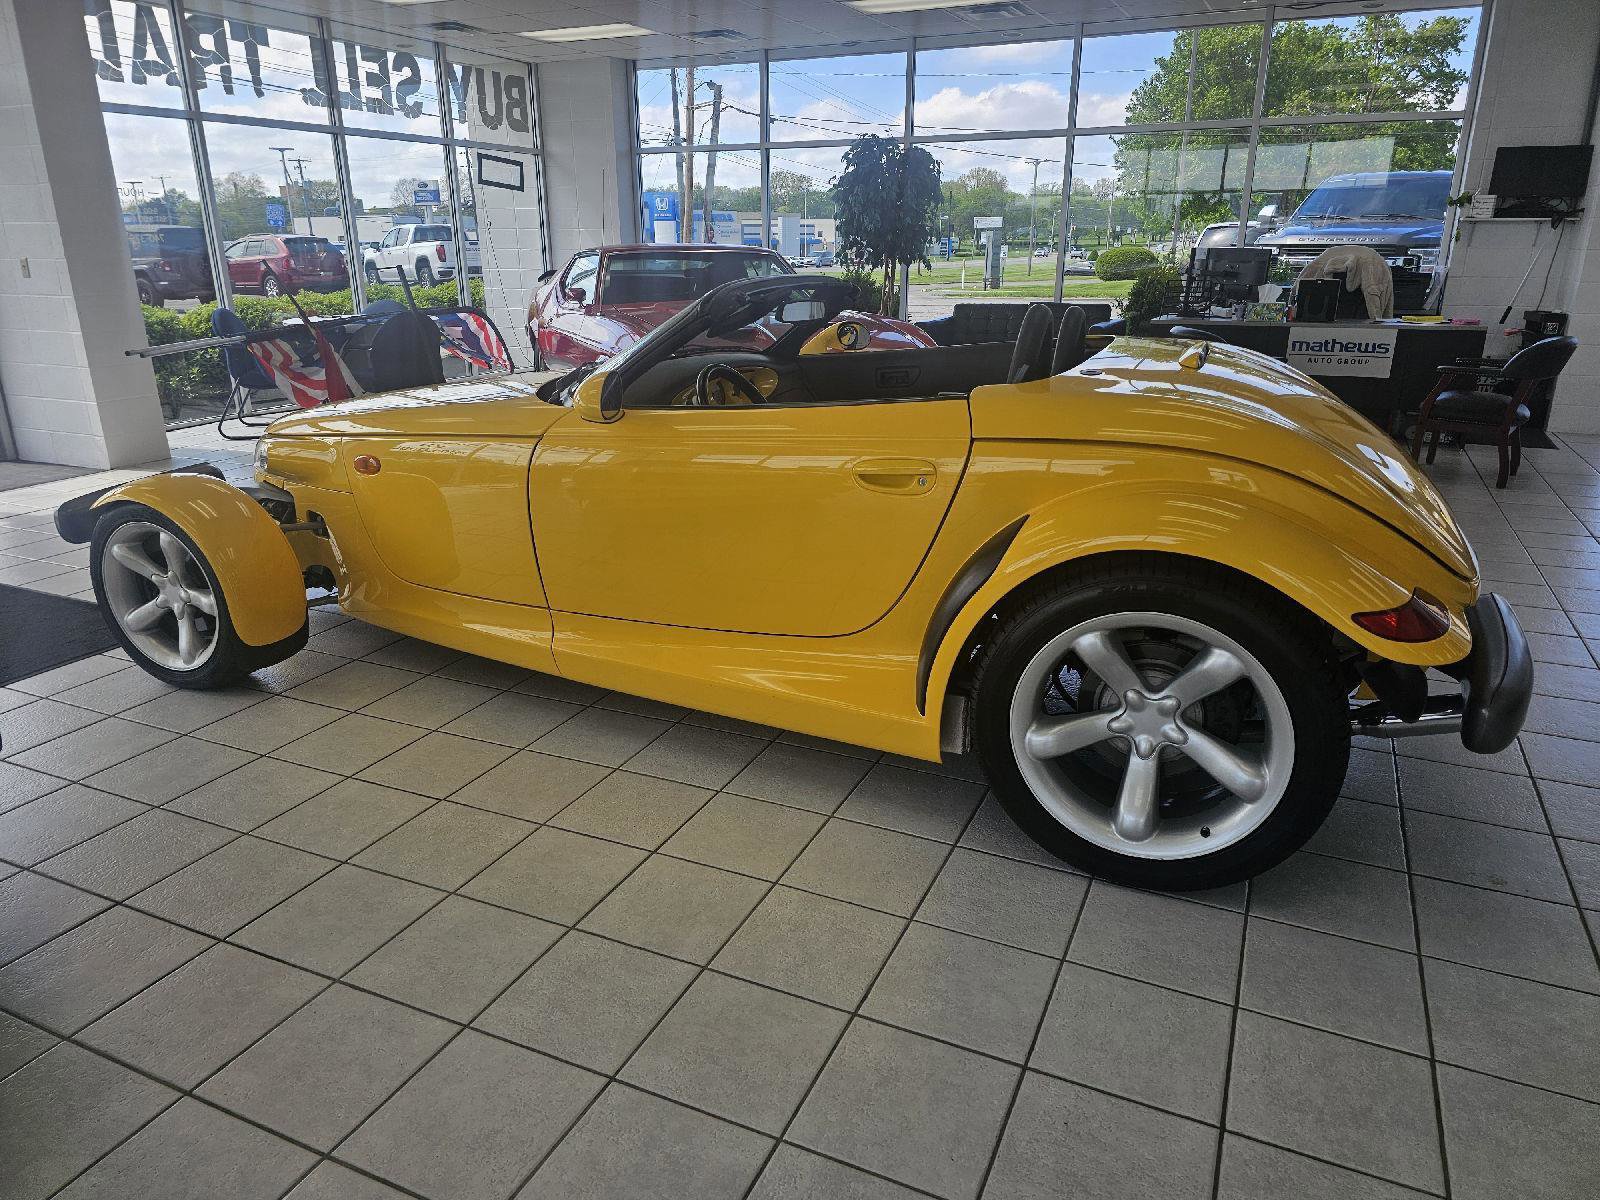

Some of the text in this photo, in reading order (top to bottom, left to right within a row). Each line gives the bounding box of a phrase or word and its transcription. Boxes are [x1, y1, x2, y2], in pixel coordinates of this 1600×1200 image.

[1291, 338, 1391, 355] mathews
[1307, 357, 1370, 366] AUTO GROUP
